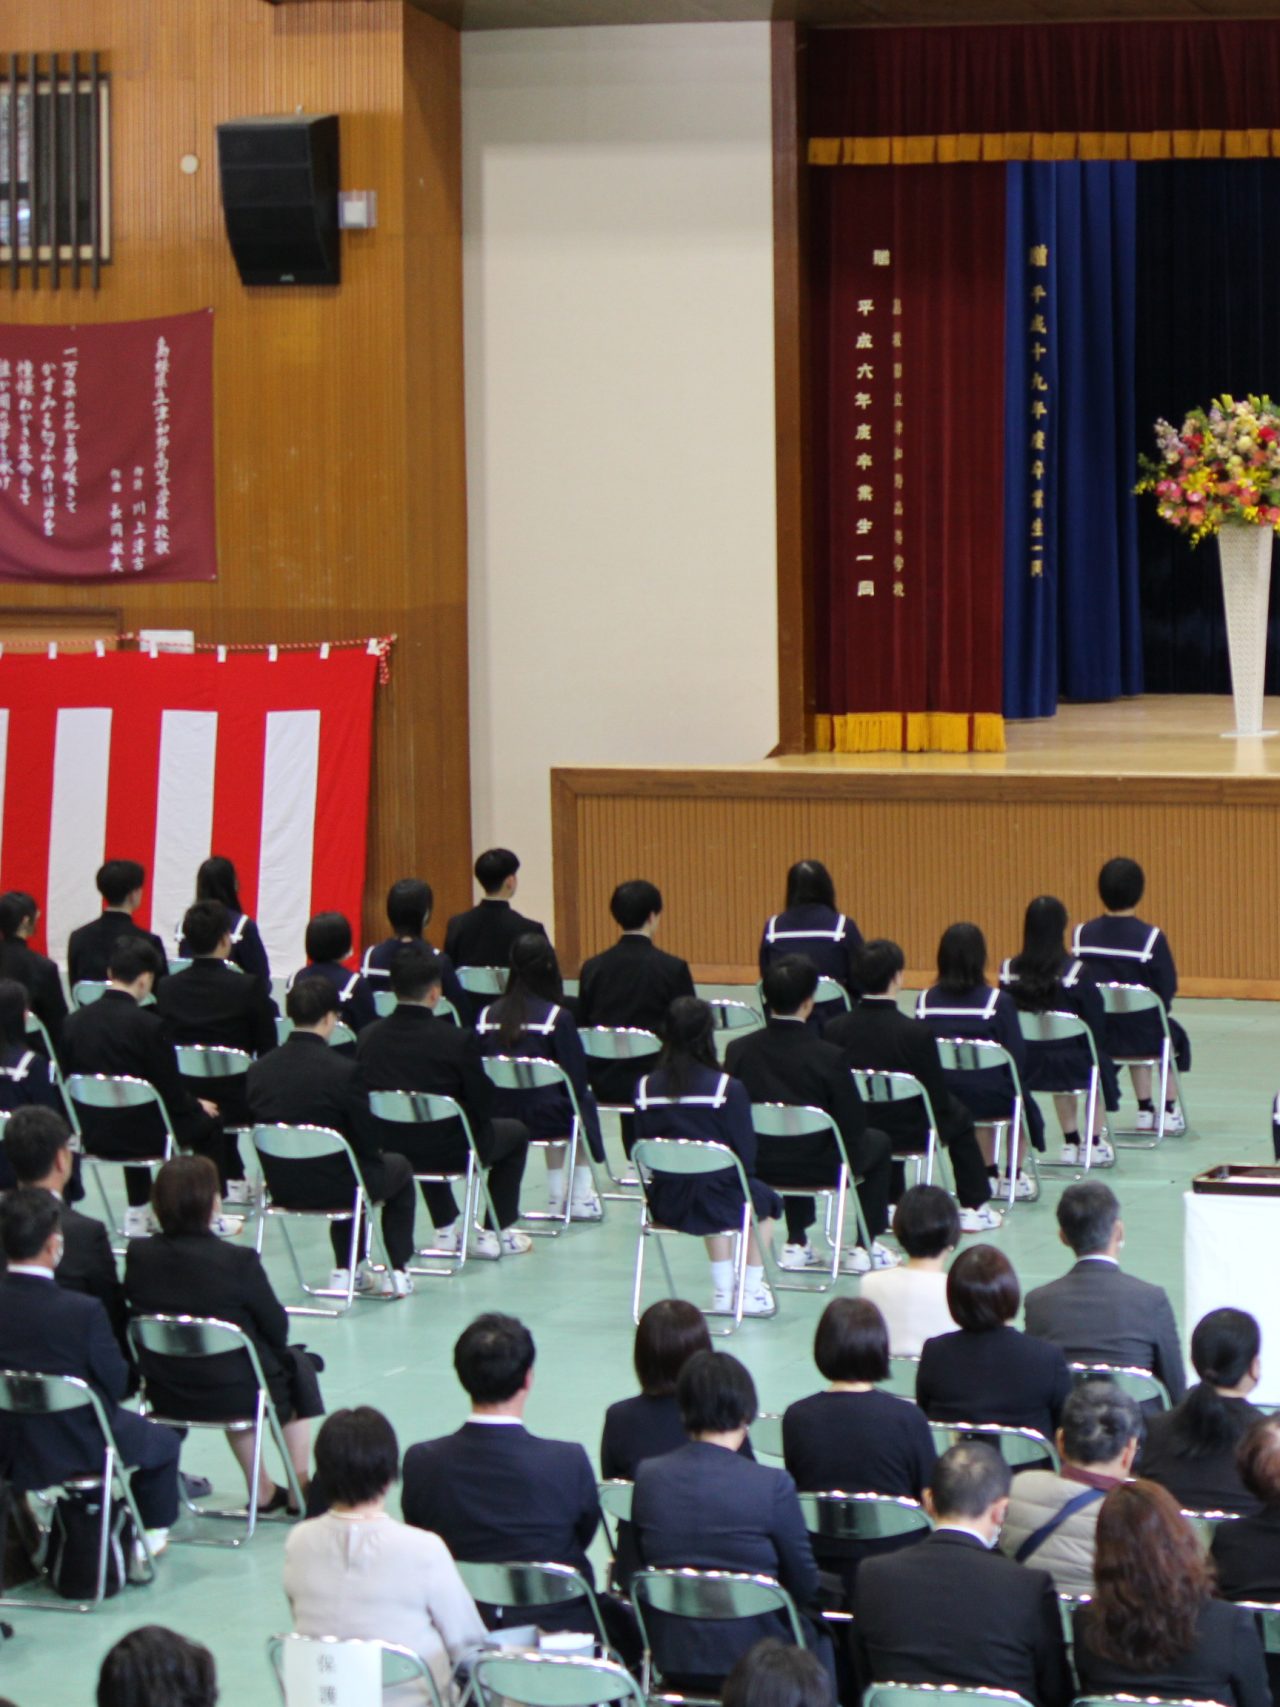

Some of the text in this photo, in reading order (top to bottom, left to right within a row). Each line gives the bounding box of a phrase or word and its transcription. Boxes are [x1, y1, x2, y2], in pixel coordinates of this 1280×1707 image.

[854, 299, 875, 597] 平成六年度卒業生一同
